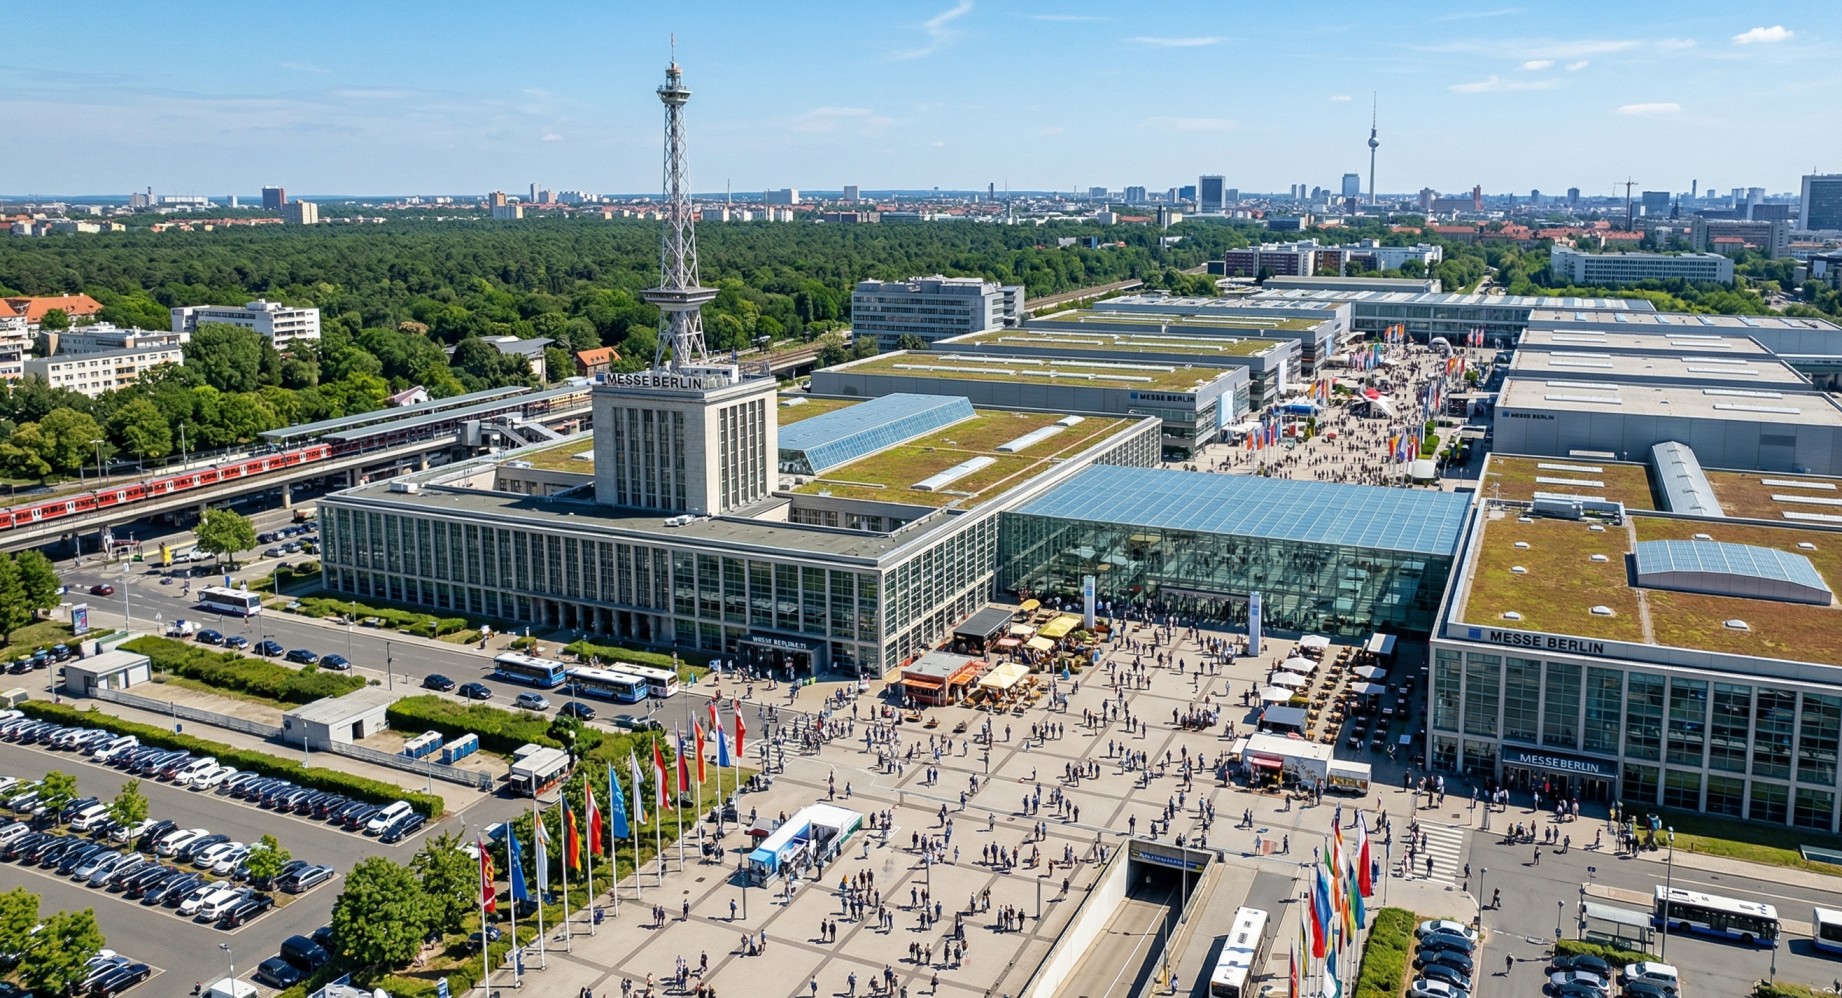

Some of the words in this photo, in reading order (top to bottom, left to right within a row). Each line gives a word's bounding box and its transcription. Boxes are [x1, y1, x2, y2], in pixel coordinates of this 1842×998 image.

[607, 373, 649, 386] MESSE
[652, 376, 702, 389] BERLIN
[1140, 393, 1165, 402] MESSE
[1490, 631, 1541, 647] MESSE
[1547, 637, 1604, 654] BERLIN
